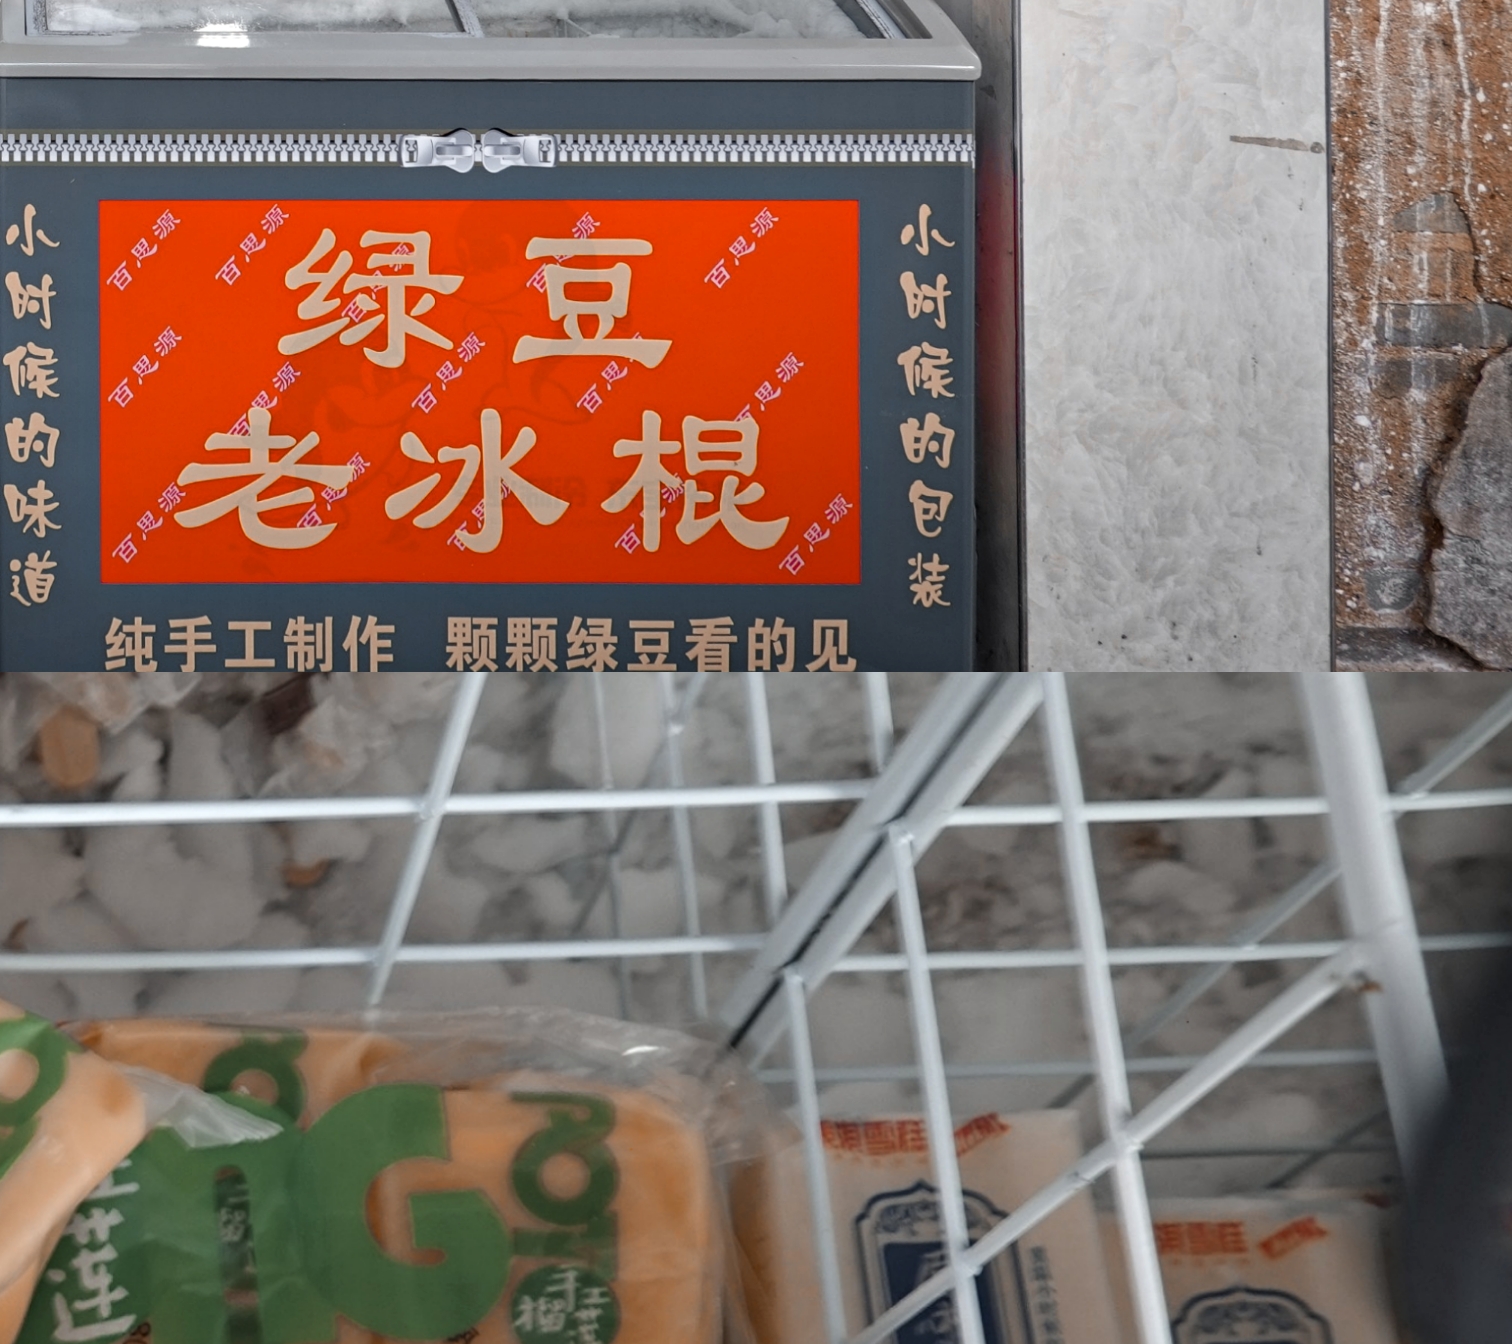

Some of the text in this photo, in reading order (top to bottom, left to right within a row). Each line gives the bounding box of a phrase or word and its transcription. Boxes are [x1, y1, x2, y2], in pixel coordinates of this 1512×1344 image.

[107, 209, 181, 292] 百思源
[705, 207, 779, 289] 百思源
[278, 228, 673, 368] 绿豆
[3, 204, 62, 606] 小时候的味道
[108, 326, 182, 409] 百思源
[412, 331, 486, 415] 百思源
[898, 204, 955, 607] 小时候的包装
[174, 407, 790, 554] 老冰棍
[779, 493, 853, 576] 百思源
[104, 615, 857, 672] 纯手工制作 颗颗绿豆看的见
